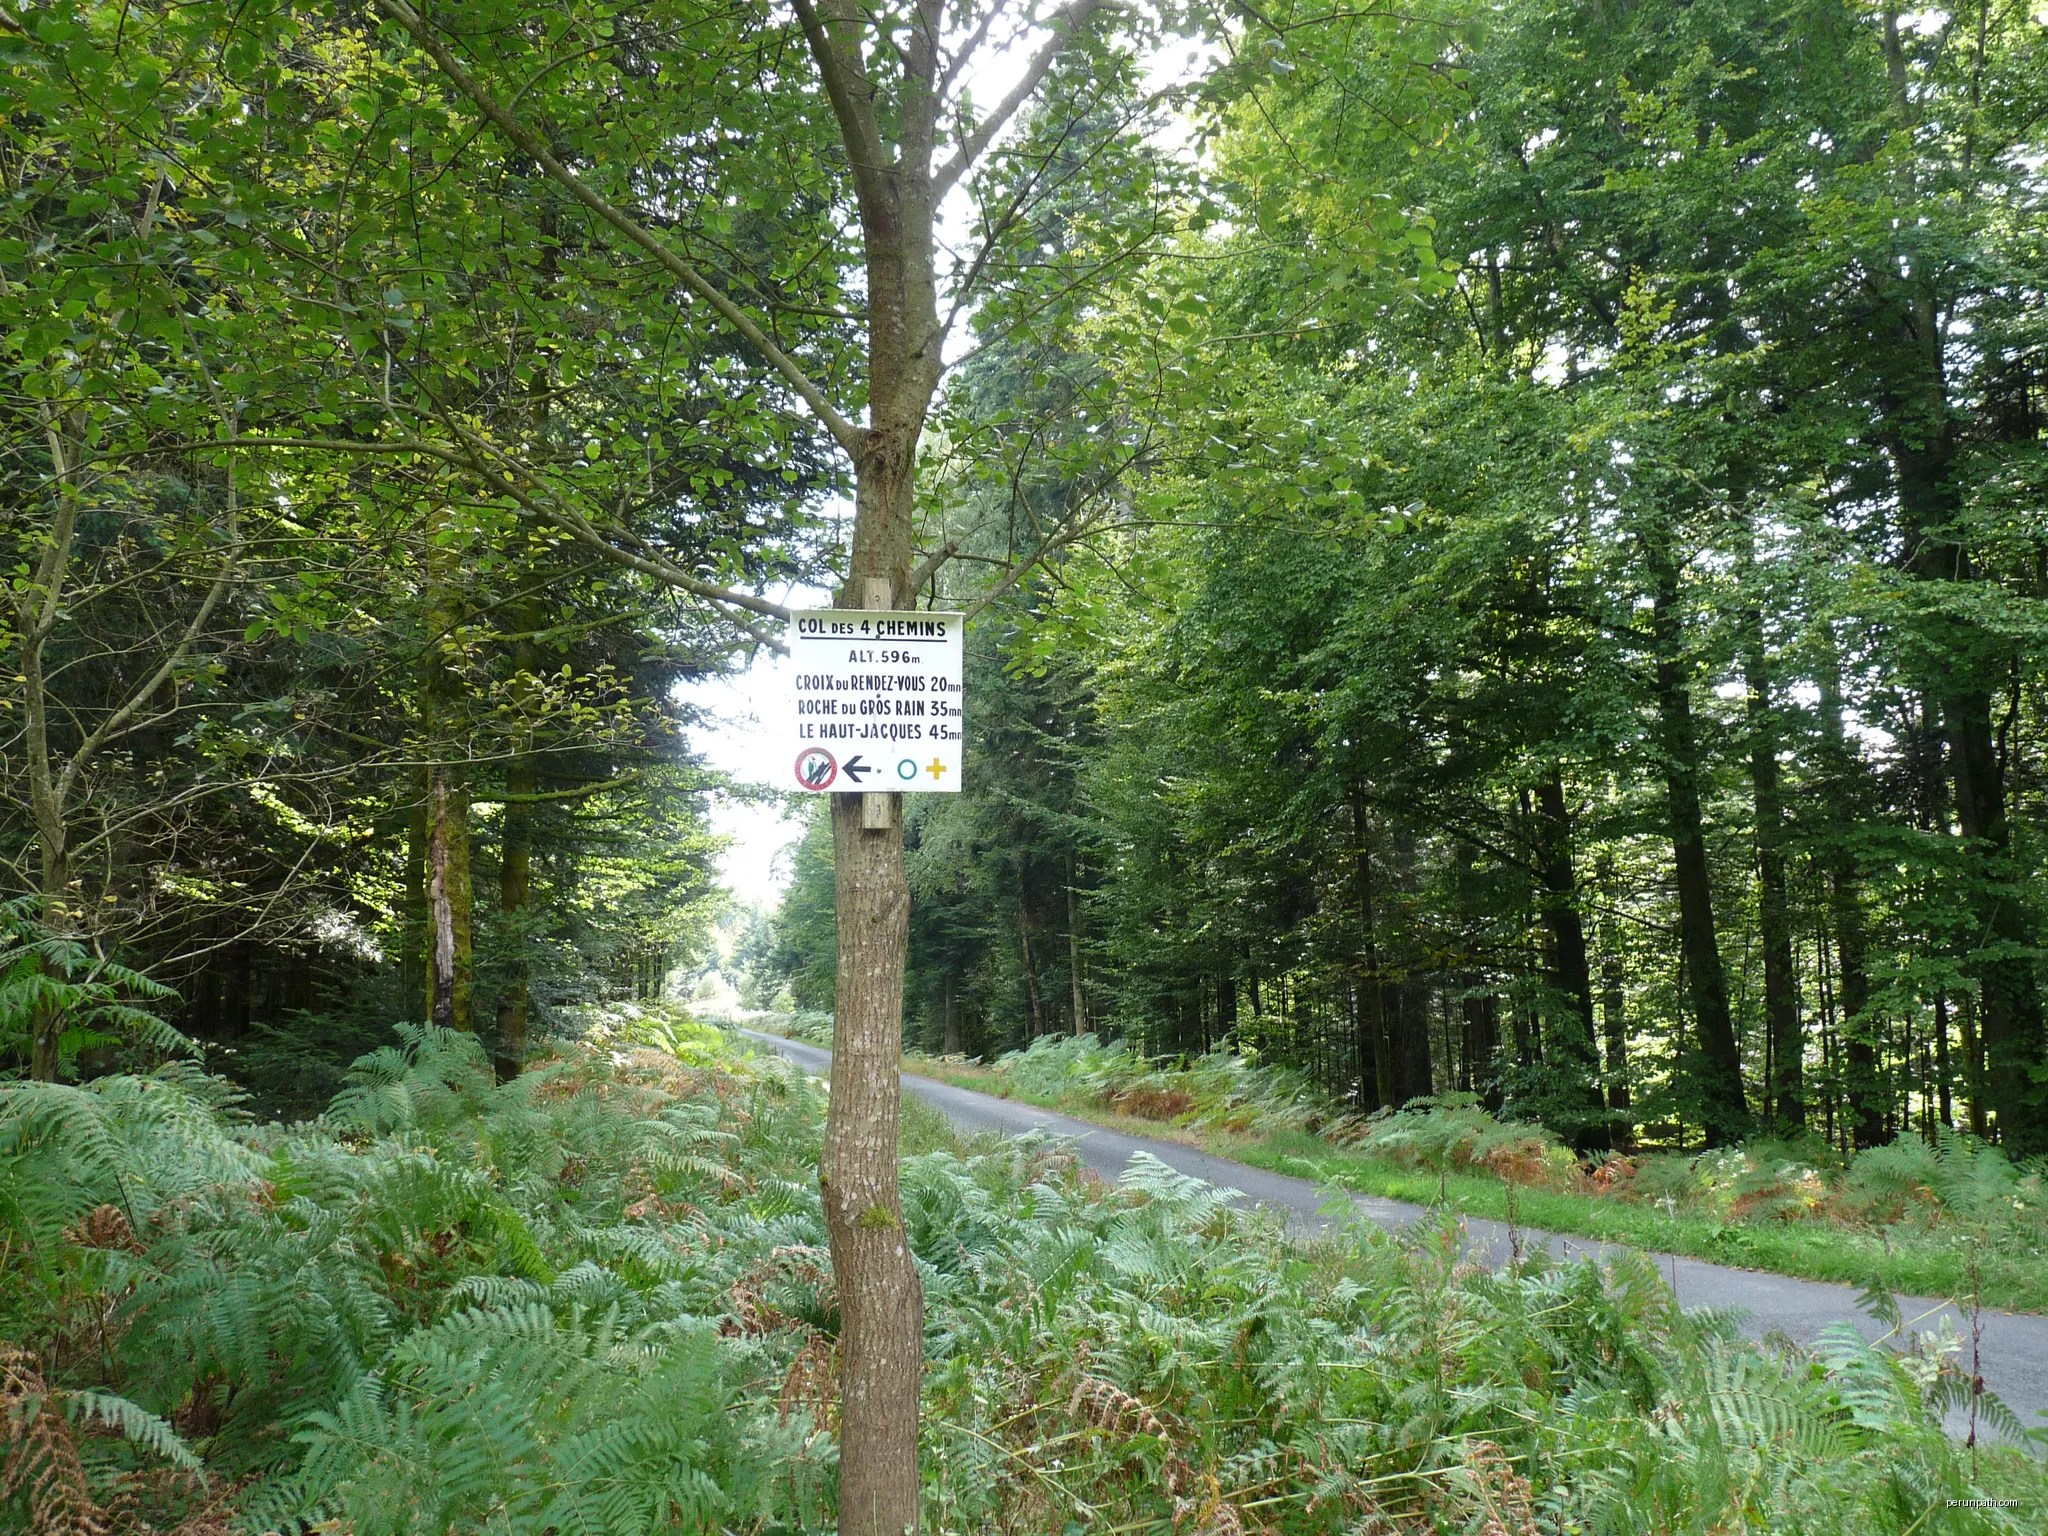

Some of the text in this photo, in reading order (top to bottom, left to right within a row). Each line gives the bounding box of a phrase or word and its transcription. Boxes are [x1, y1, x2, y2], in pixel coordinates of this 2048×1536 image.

[798, 618, 827, 634] COL
[860, 619, 871, 635] 4
[876, 620, 946, 637] CHEMINS
[796, 674, 834, 691] CROIX
[851, 675, 926, 692] RENDEZ-VOUS
[798, 699, 838, 715] ROCHE
[860, 700, 891, 716] GROS
[895, 700, 925, 716] RAIN
[799, 723, 814, 739] LE
[820, 723, 922, 742] HAUT-JACQUES
